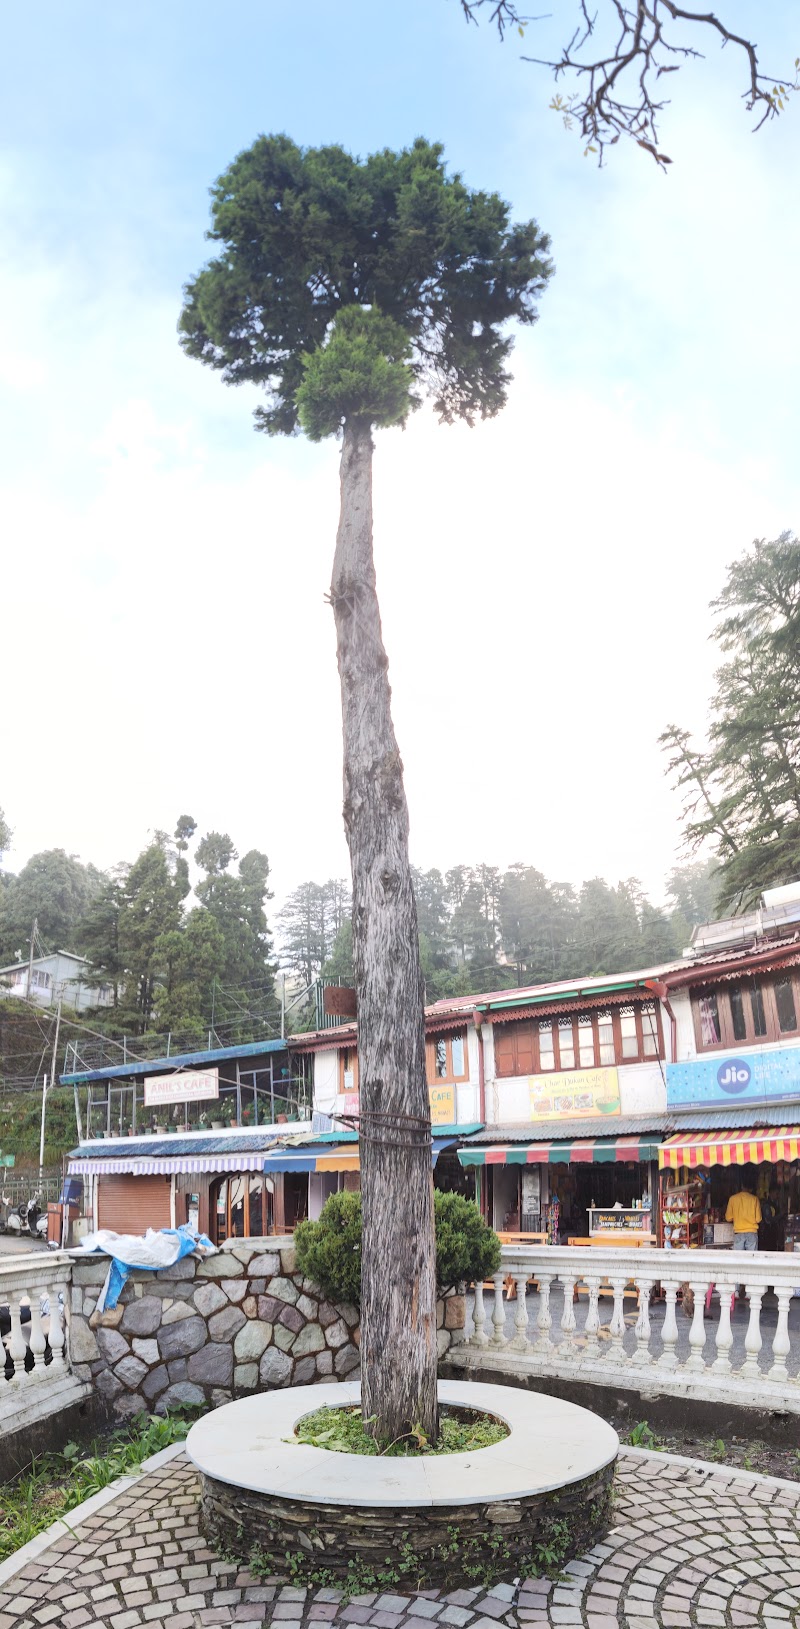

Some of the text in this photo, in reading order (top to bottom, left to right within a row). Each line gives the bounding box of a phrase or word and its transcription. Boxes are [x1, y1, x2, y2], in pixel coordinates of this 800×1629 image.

[754, 1063, 783, 1073] DIGITAL
[586, 1075, 602, 1084] Cafe
[720, 1067, 749, 1083] Jio
[151, 1077, 210, 1094] ANIL'S CAFE
